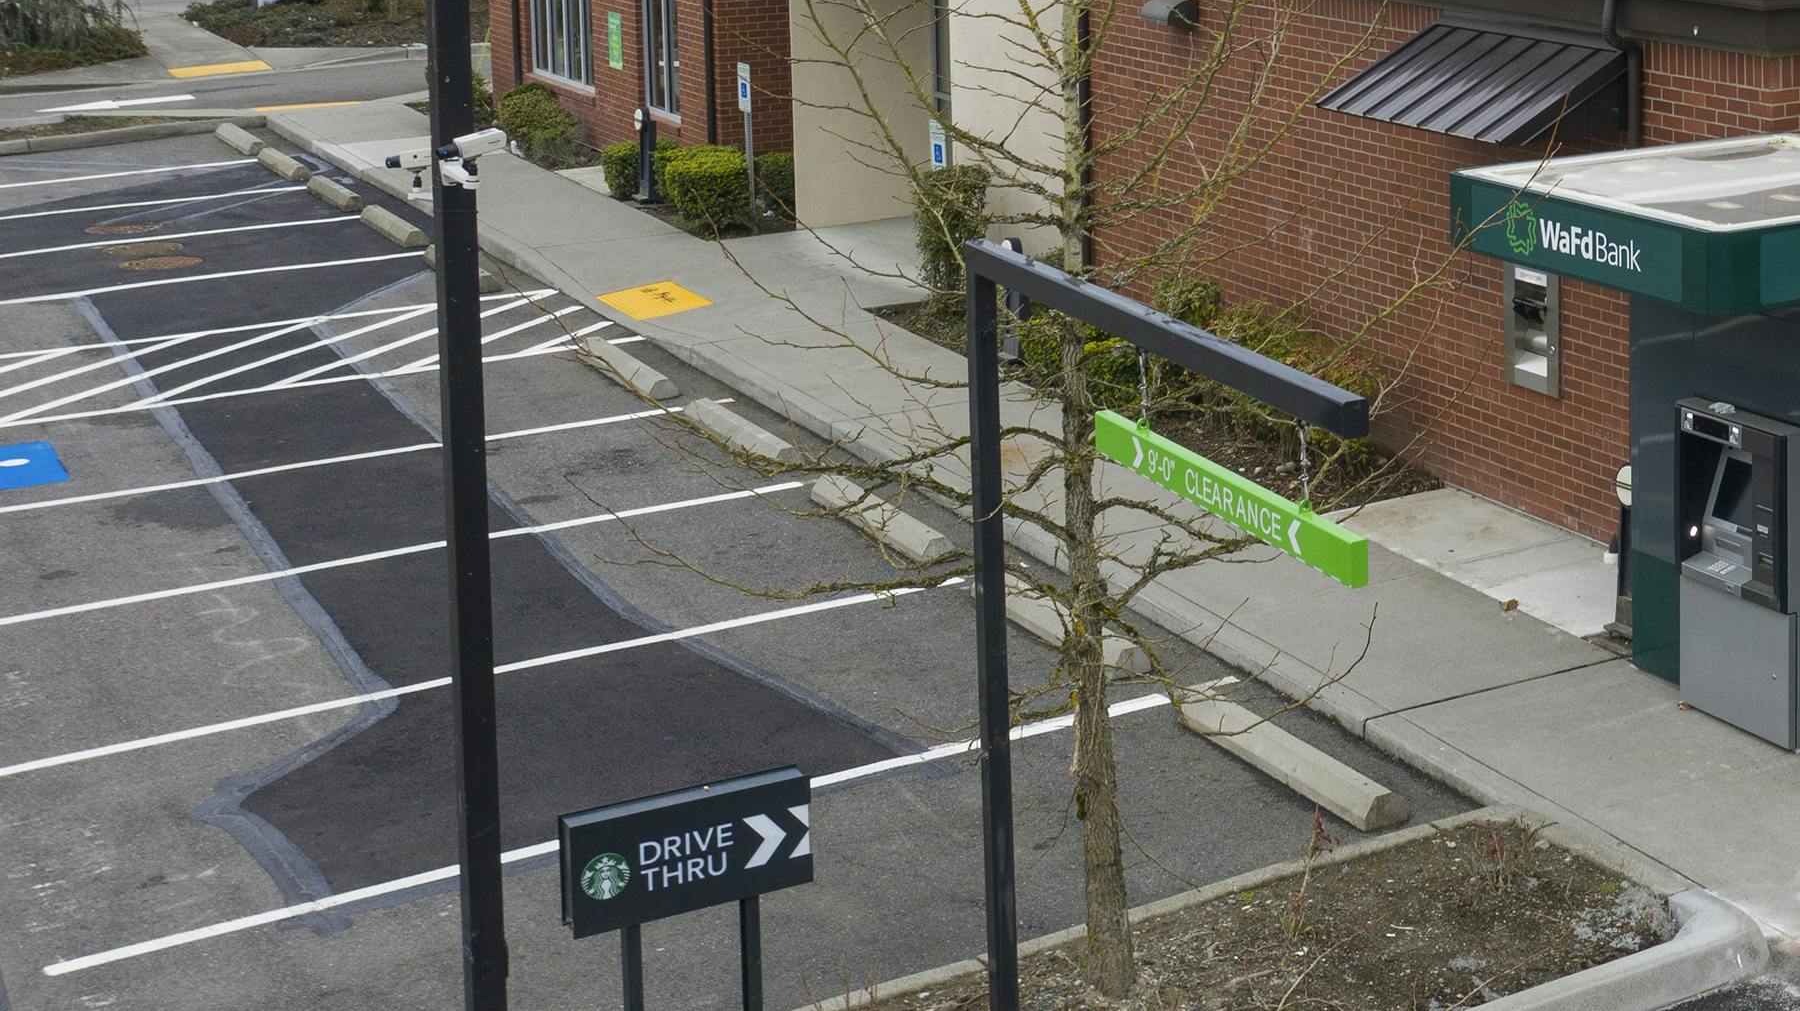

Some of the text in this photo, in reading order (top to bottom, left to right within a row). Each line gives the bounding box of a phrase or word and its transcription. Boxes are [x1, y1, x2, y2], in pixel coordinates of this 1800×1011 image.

[1147, 449, 1282, 541] 9'-0" CLEARANCE
[639, 823, 734, 866] DRIVE
[640, 852, 728, 891] THRU
